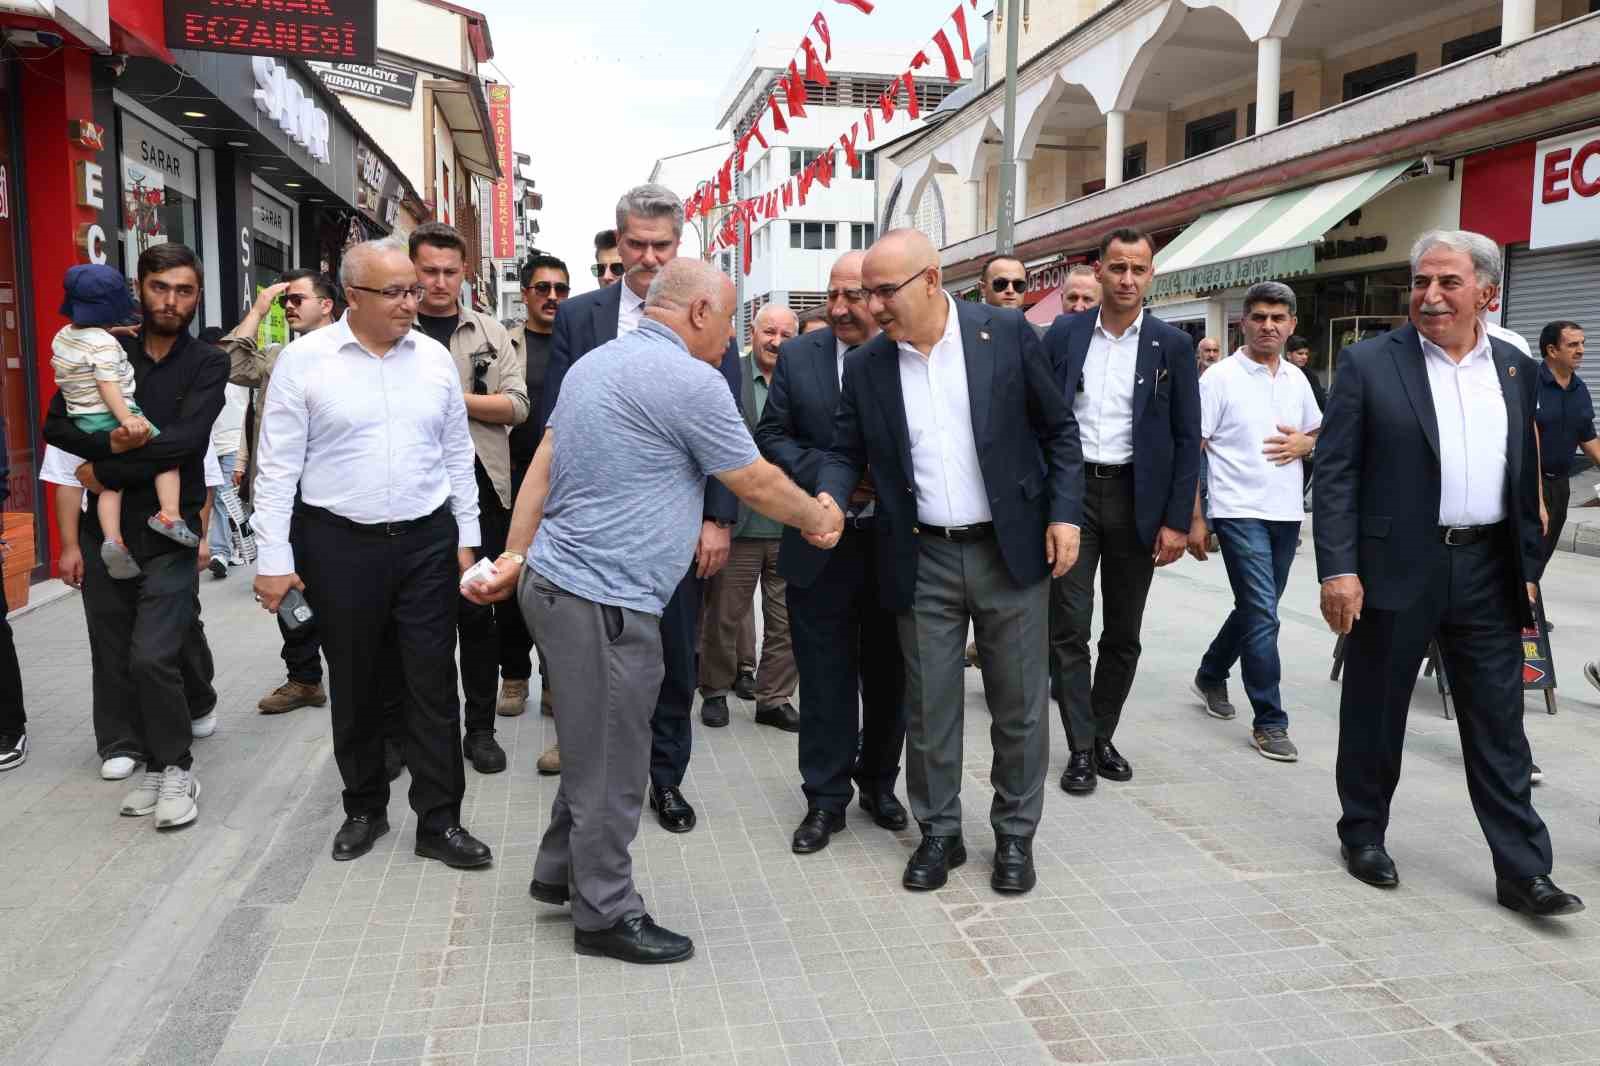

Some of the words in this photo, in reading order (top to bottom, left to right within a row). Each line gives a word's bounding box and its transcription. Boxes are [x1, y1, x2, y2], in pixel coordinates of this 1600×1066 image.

[185, 13, 357, 56] ECZANESİ
[324, 73, 383, 95] HIRDAVAT
[141, 140, 181, 177] SARAR
[261, 207, 282, 230] SARAR
